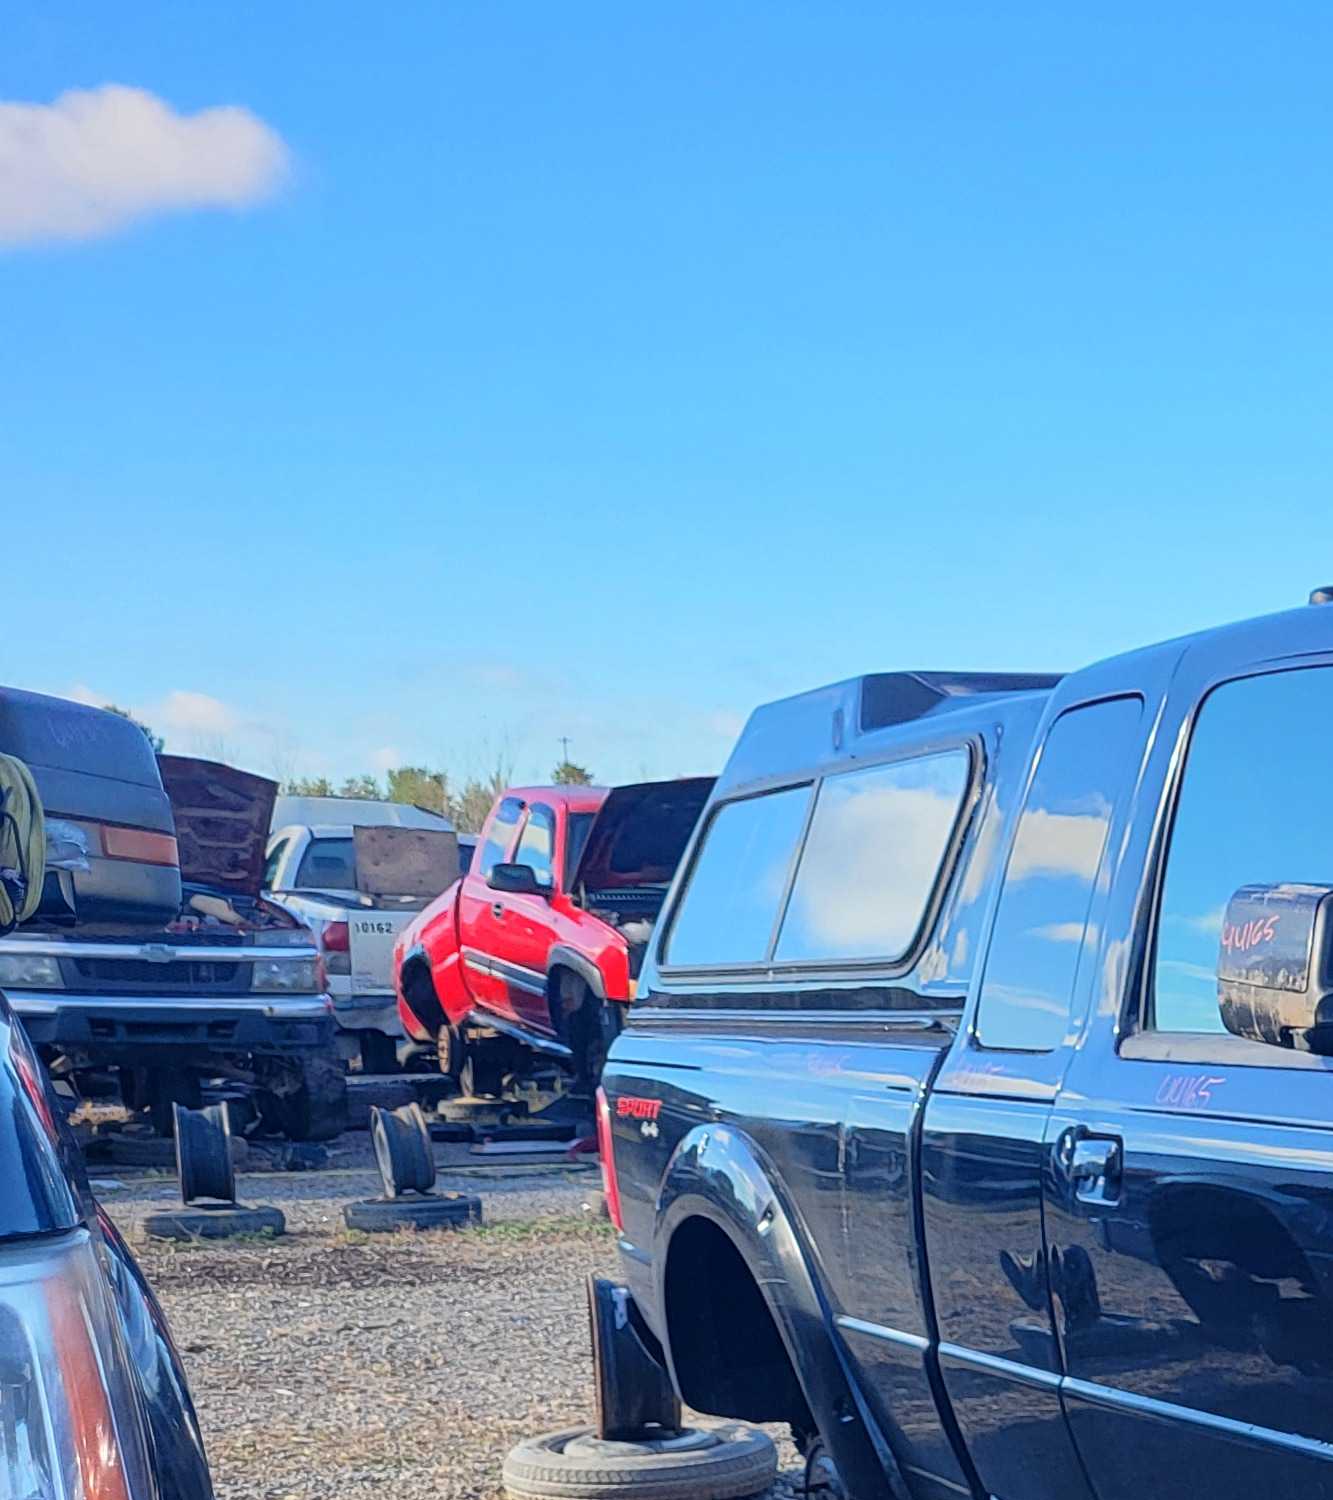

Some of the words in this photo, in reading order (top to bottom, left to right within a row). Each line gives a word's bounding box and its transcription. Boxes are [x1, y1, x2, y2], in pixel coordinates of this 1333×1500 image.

[354, 921, 393, 934] 10162
[1222, 914, 1280, 954] 44165
[616, 1097, 663, 1119] SPORT
